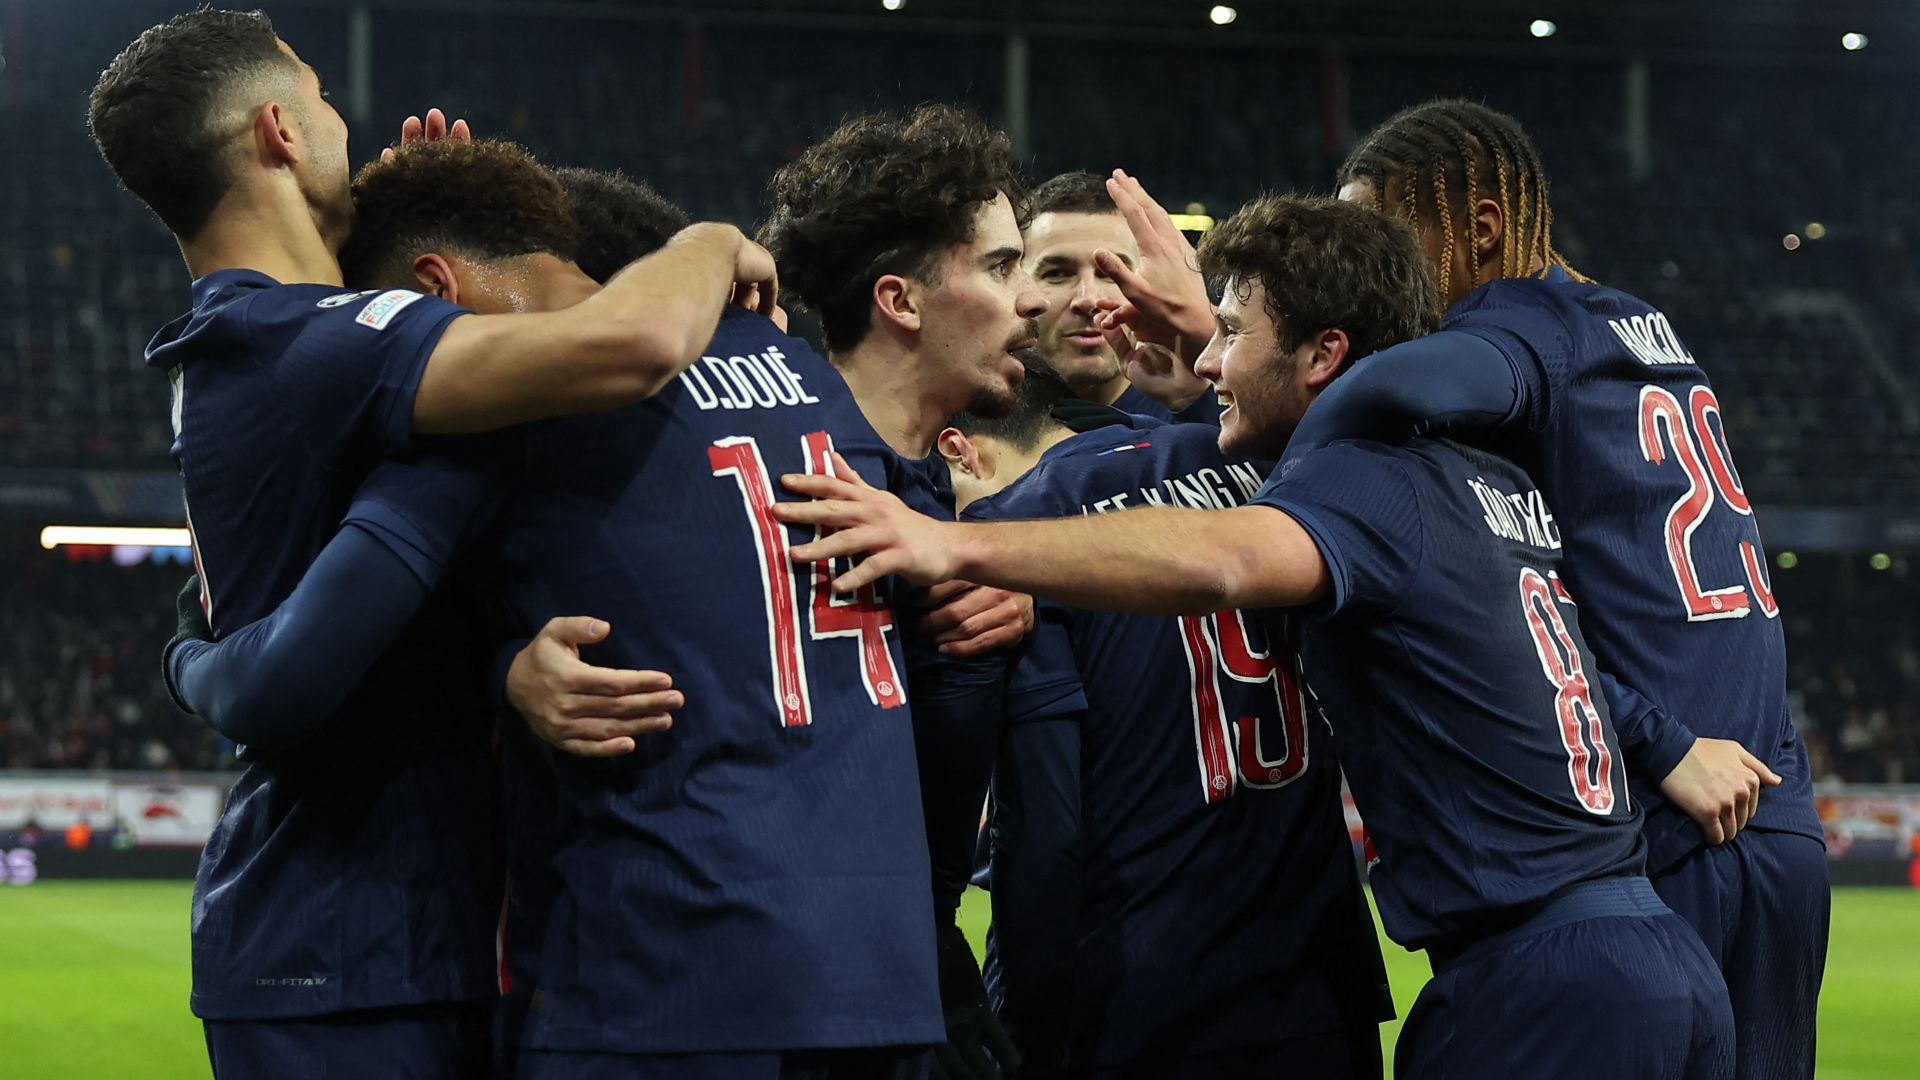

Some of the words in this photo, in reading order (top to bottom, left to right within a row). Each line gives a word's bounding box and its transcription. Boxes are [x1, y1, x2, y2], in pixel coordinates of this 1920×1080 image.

[1607, 311, 1696, 365] BARCOL
[707, 429, 907, 728] 14
[1638, 384, 1779, 622] 29
[1177, 608, 1310, 805] 19
